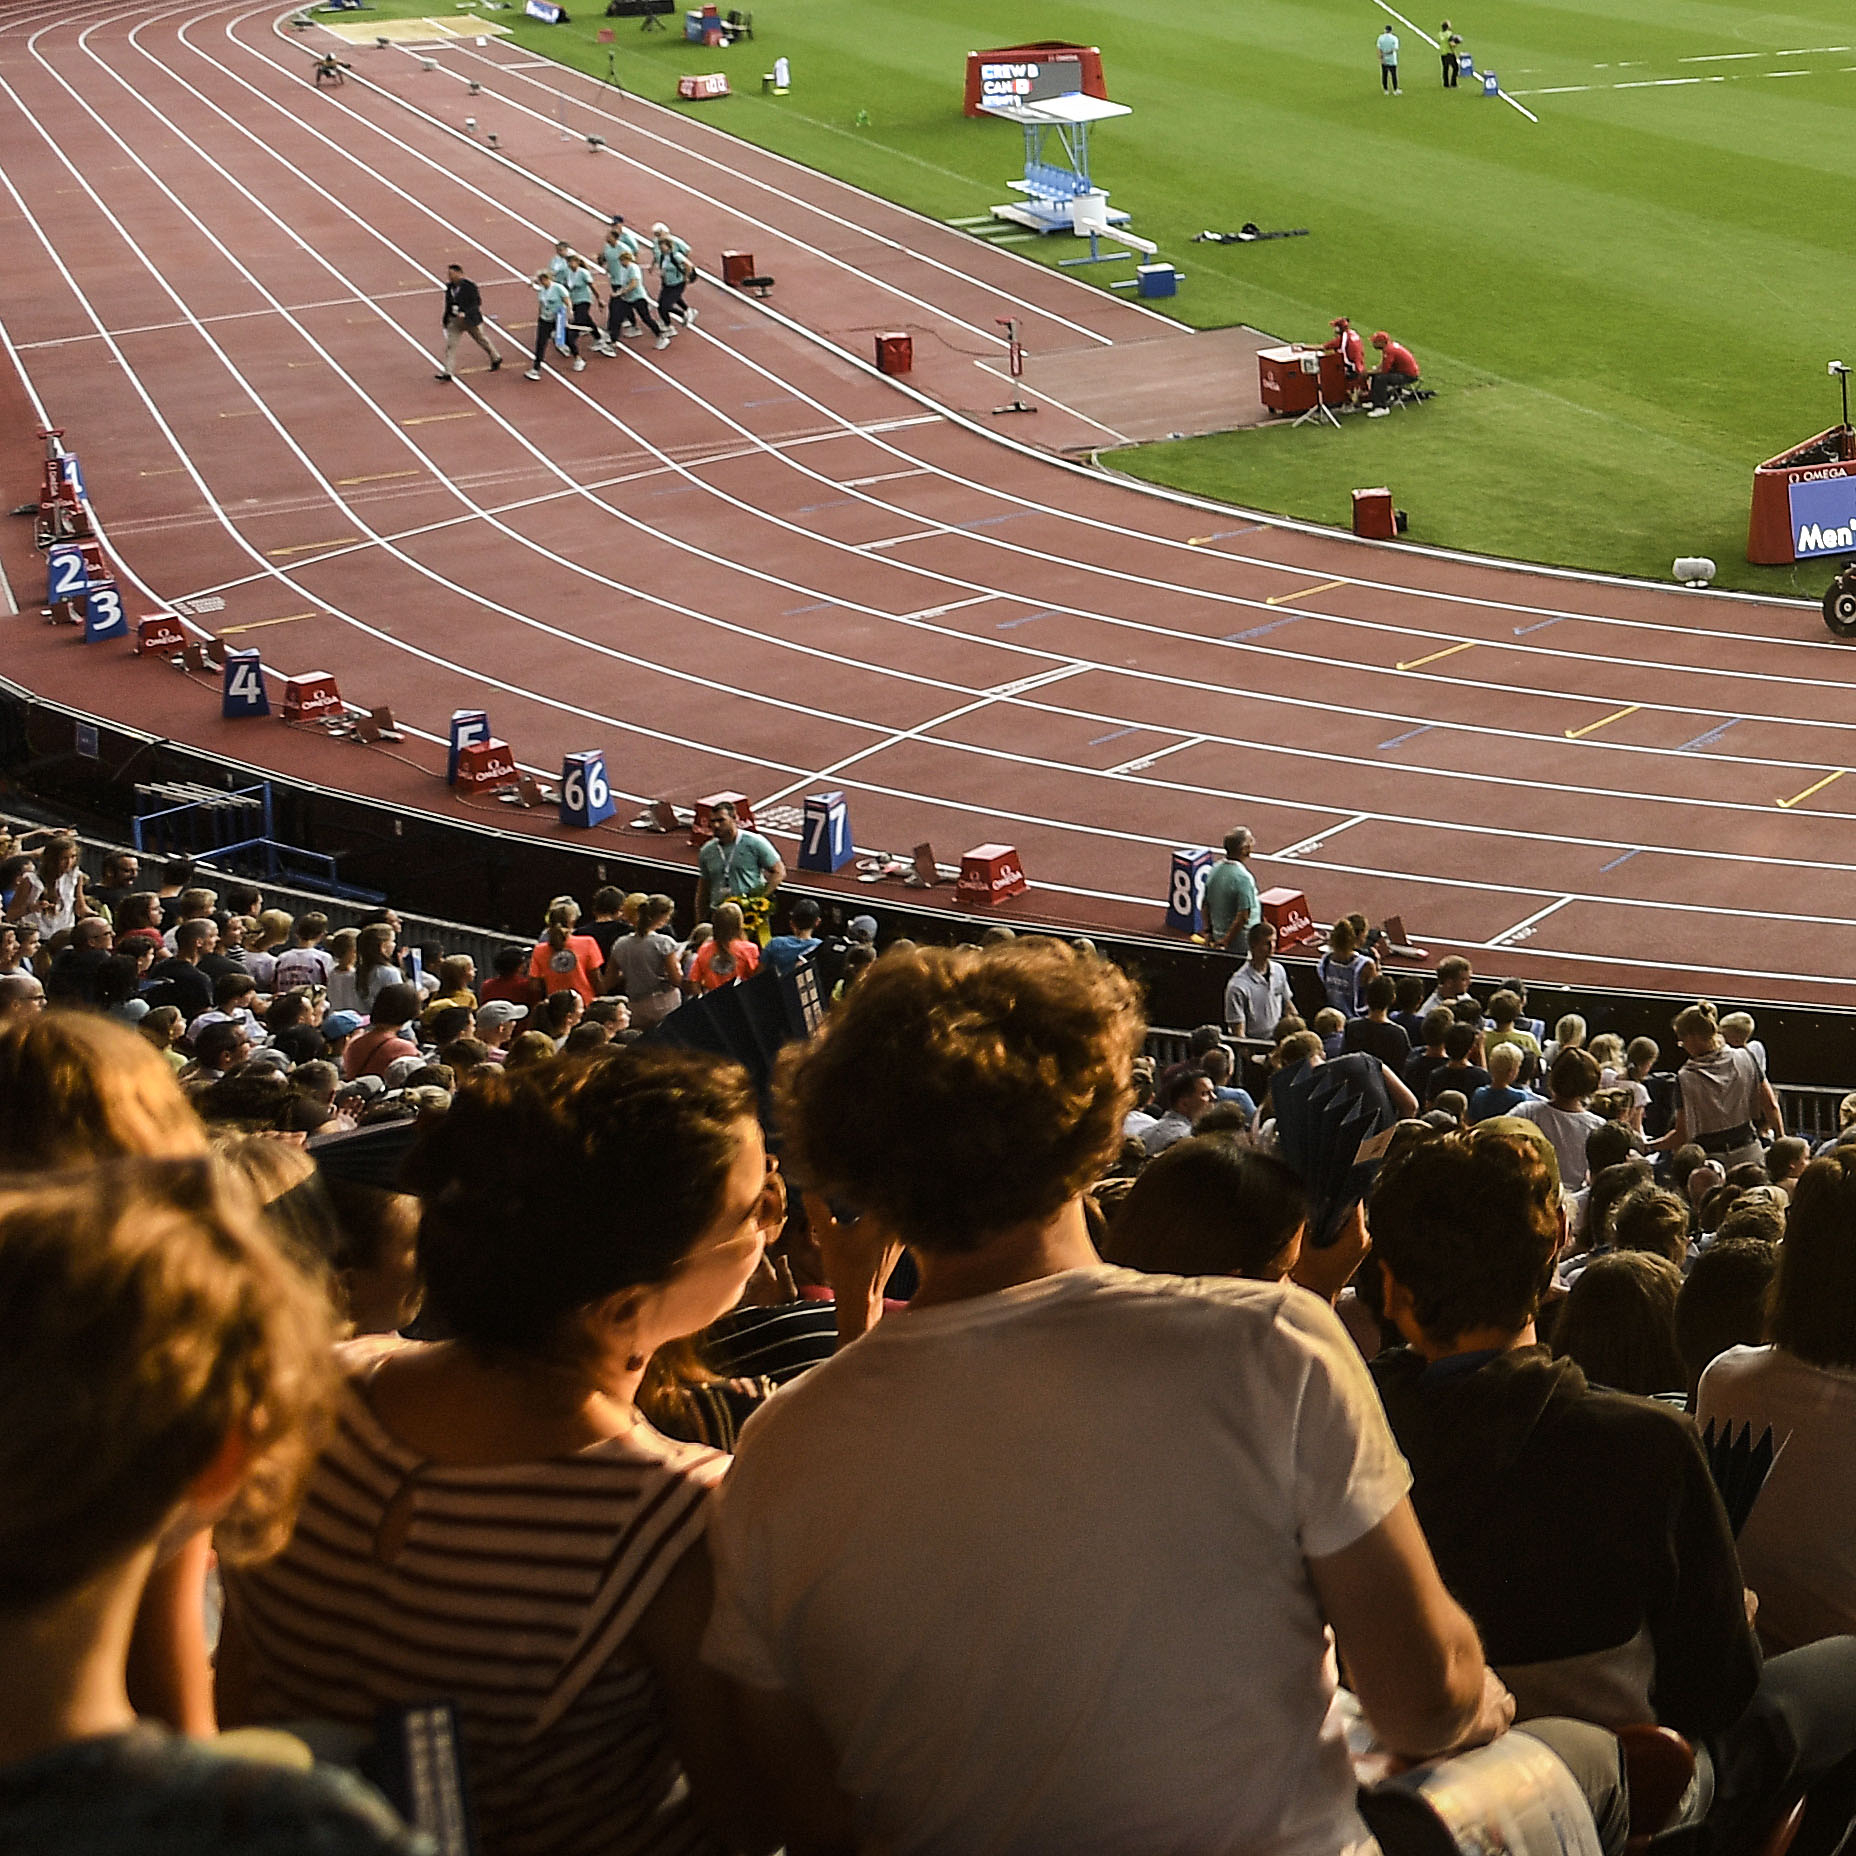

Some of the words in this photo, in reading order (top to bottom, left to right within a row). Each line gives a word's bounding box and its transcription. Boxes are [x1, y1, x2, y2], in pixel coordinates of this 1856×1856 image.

[65, 460, 83, 494] 1
[1803, 467, 1848, 482] OMEGA
[52, 554, 87, 594] 2
[89, 590, 122, 631] 3
[229, 664, 261, 704] 4
[564, 769, 585, 812] 6
[588, 761, 609, 809] 6
[806, 811, 827, 855] 7
[829, 802, 847, 856] 7
[1173, 869, 1192, 916] 8
